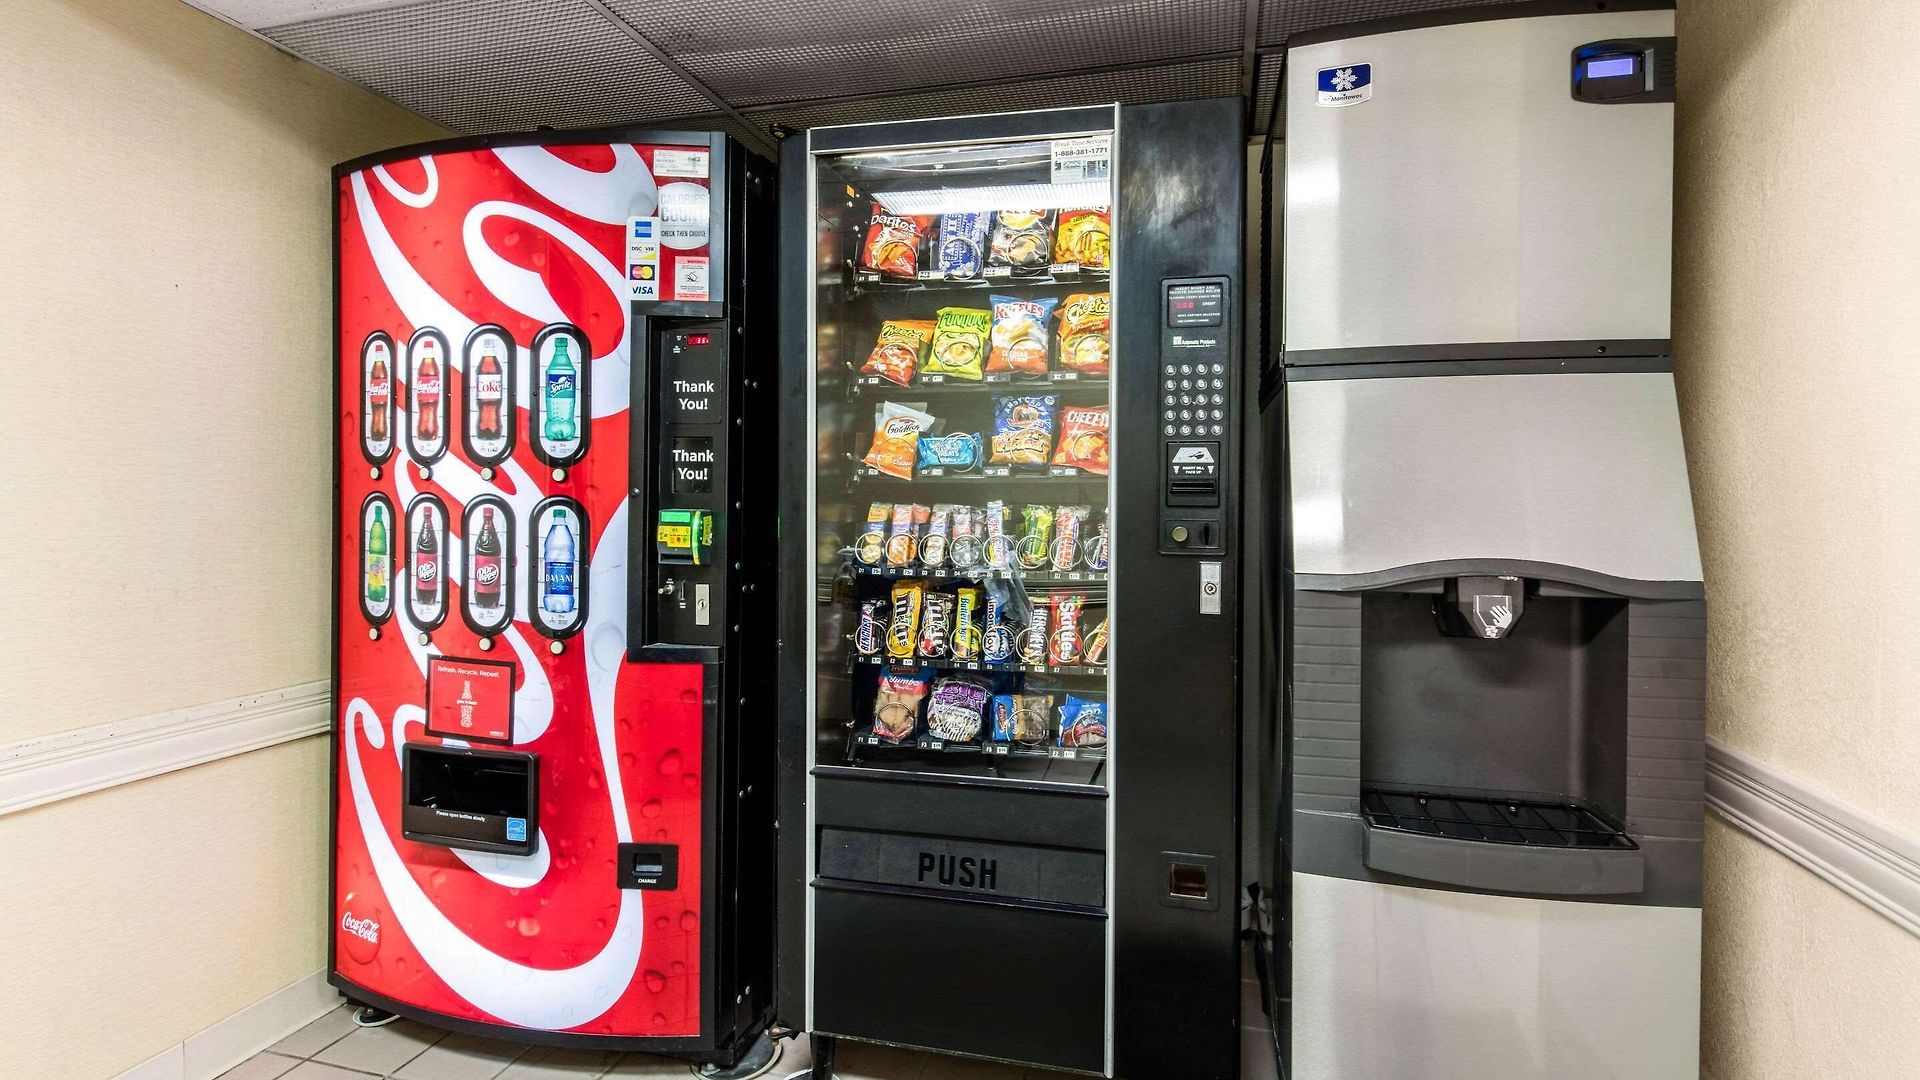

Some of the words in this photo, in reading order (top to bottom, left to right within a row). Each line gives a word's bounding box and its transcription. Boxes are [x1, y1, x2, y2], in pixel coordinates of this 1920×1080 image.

[1331, 94, 1363, 102] Manitowoc
[870, 214, 916, 233] Doritos
[632, 286, 654, 295] VISA
[477, 380, 501, 393] Coke
[551, 381, 571, 395] Sprite
[673, 380, 714, 393] Thank
[679, 398, 708, 410] You!
[673, 450, 714, 462] Thank
[678, 468, 708, 480] You!
[1060, 601, 1076, 660] Skittles
[918, 852, 998, 890] PUSH
